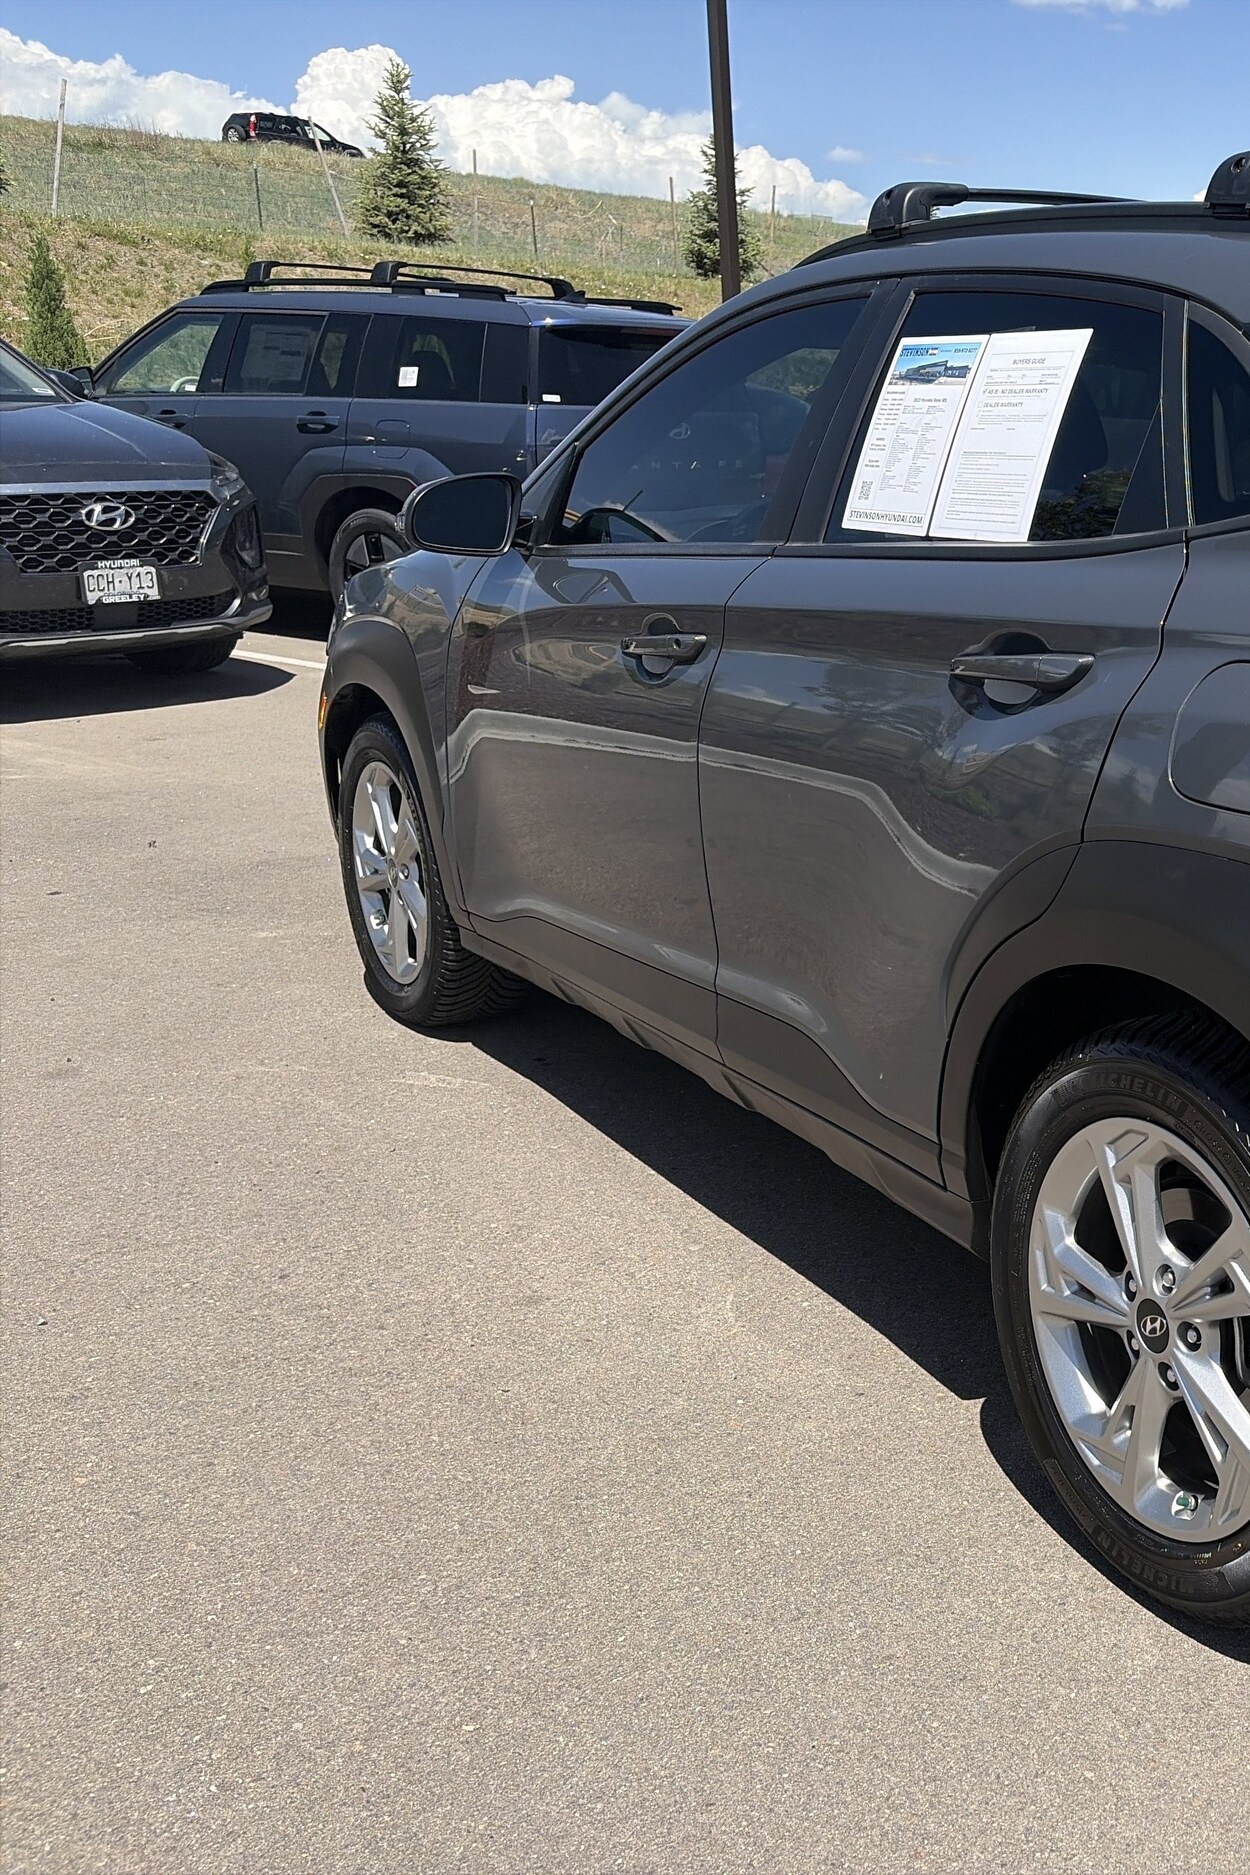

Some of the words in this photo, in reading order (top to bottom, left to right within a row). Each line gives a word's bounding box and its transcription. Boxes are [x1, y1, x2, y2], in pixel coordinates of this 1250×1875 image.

[849, 509, 923, 524] STEVINSONHYUNDAI.COM
[98, 559, 139, 568] HYUNDAI
[103, 594, 144, 603] GREELEY
[1088, 1072, 1183, 1113] MICHELIN
